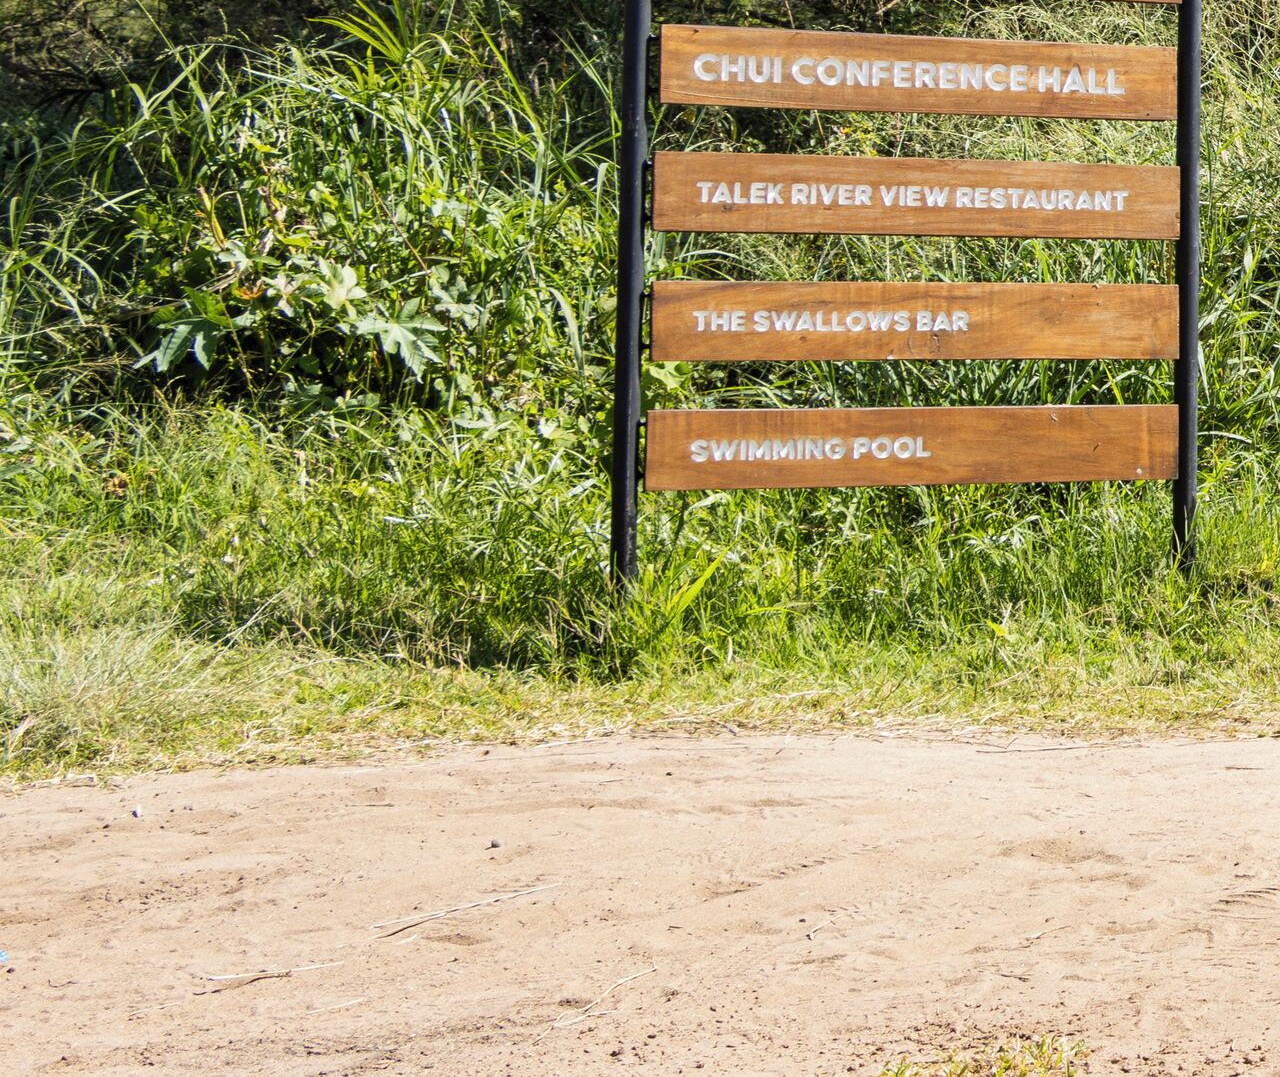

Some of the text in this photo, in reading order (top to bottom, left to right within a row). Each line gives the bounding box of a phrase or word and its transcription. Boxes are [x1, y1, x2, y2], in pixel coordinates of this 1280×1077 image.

[692, 54, 1125, 95] CHUI CONFERENCE HALL
[696, 182, 1128, 211] TALEK RIVER VIEW RESTAURANT
[693, 311, 969, 332] THE SWALLOWS BAR
[690, 437, 930, 462] SWIMMING POOL
